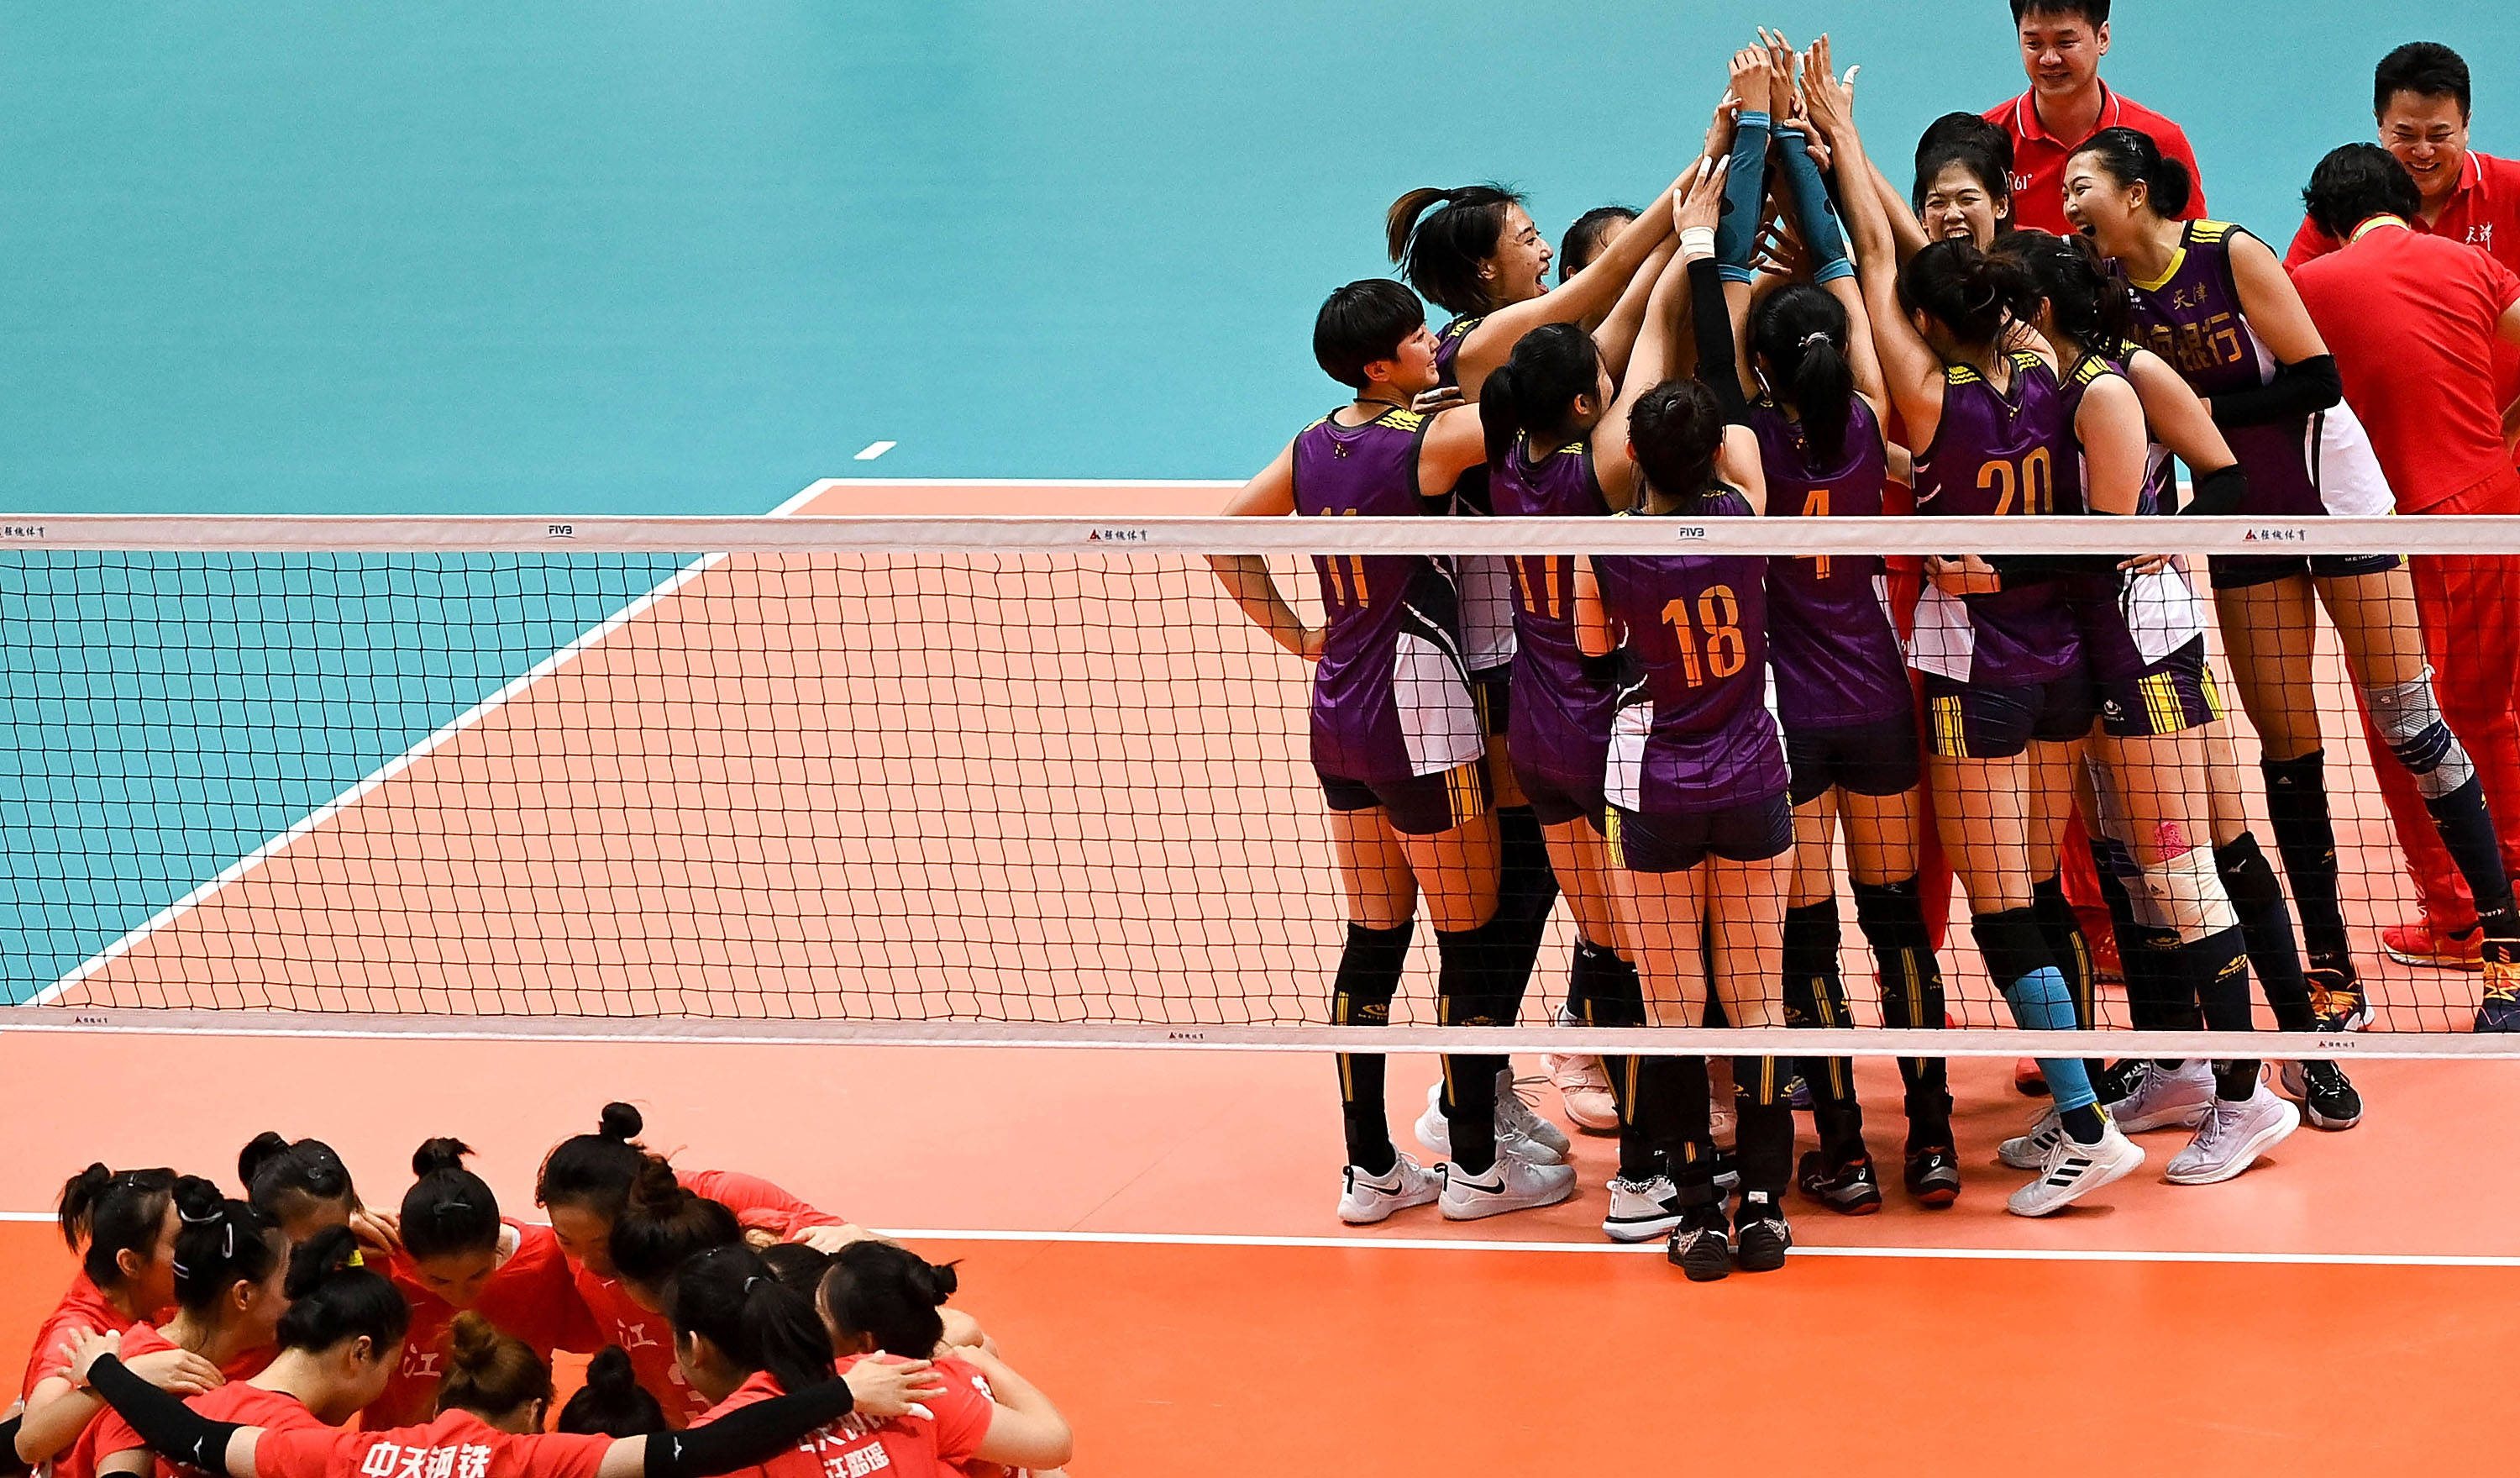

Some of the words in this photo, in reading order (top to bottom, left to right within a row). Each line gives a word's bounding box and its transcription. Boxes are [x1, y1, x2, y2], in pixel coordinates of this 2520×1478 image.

[2014, 173, 2033, 191] 61°
[2173, 281, 2208, 310] 天津
[549, 524, 573, 534] FIVB
[1680, 527, 1704, 537] FIVB
[1662, 585, 1746, 688] 18
[616, 1318, 659, 1352] 江
[402, 1343, 442, 1379] 江
[360, 1440, 492, 1478] 中天钢铁
